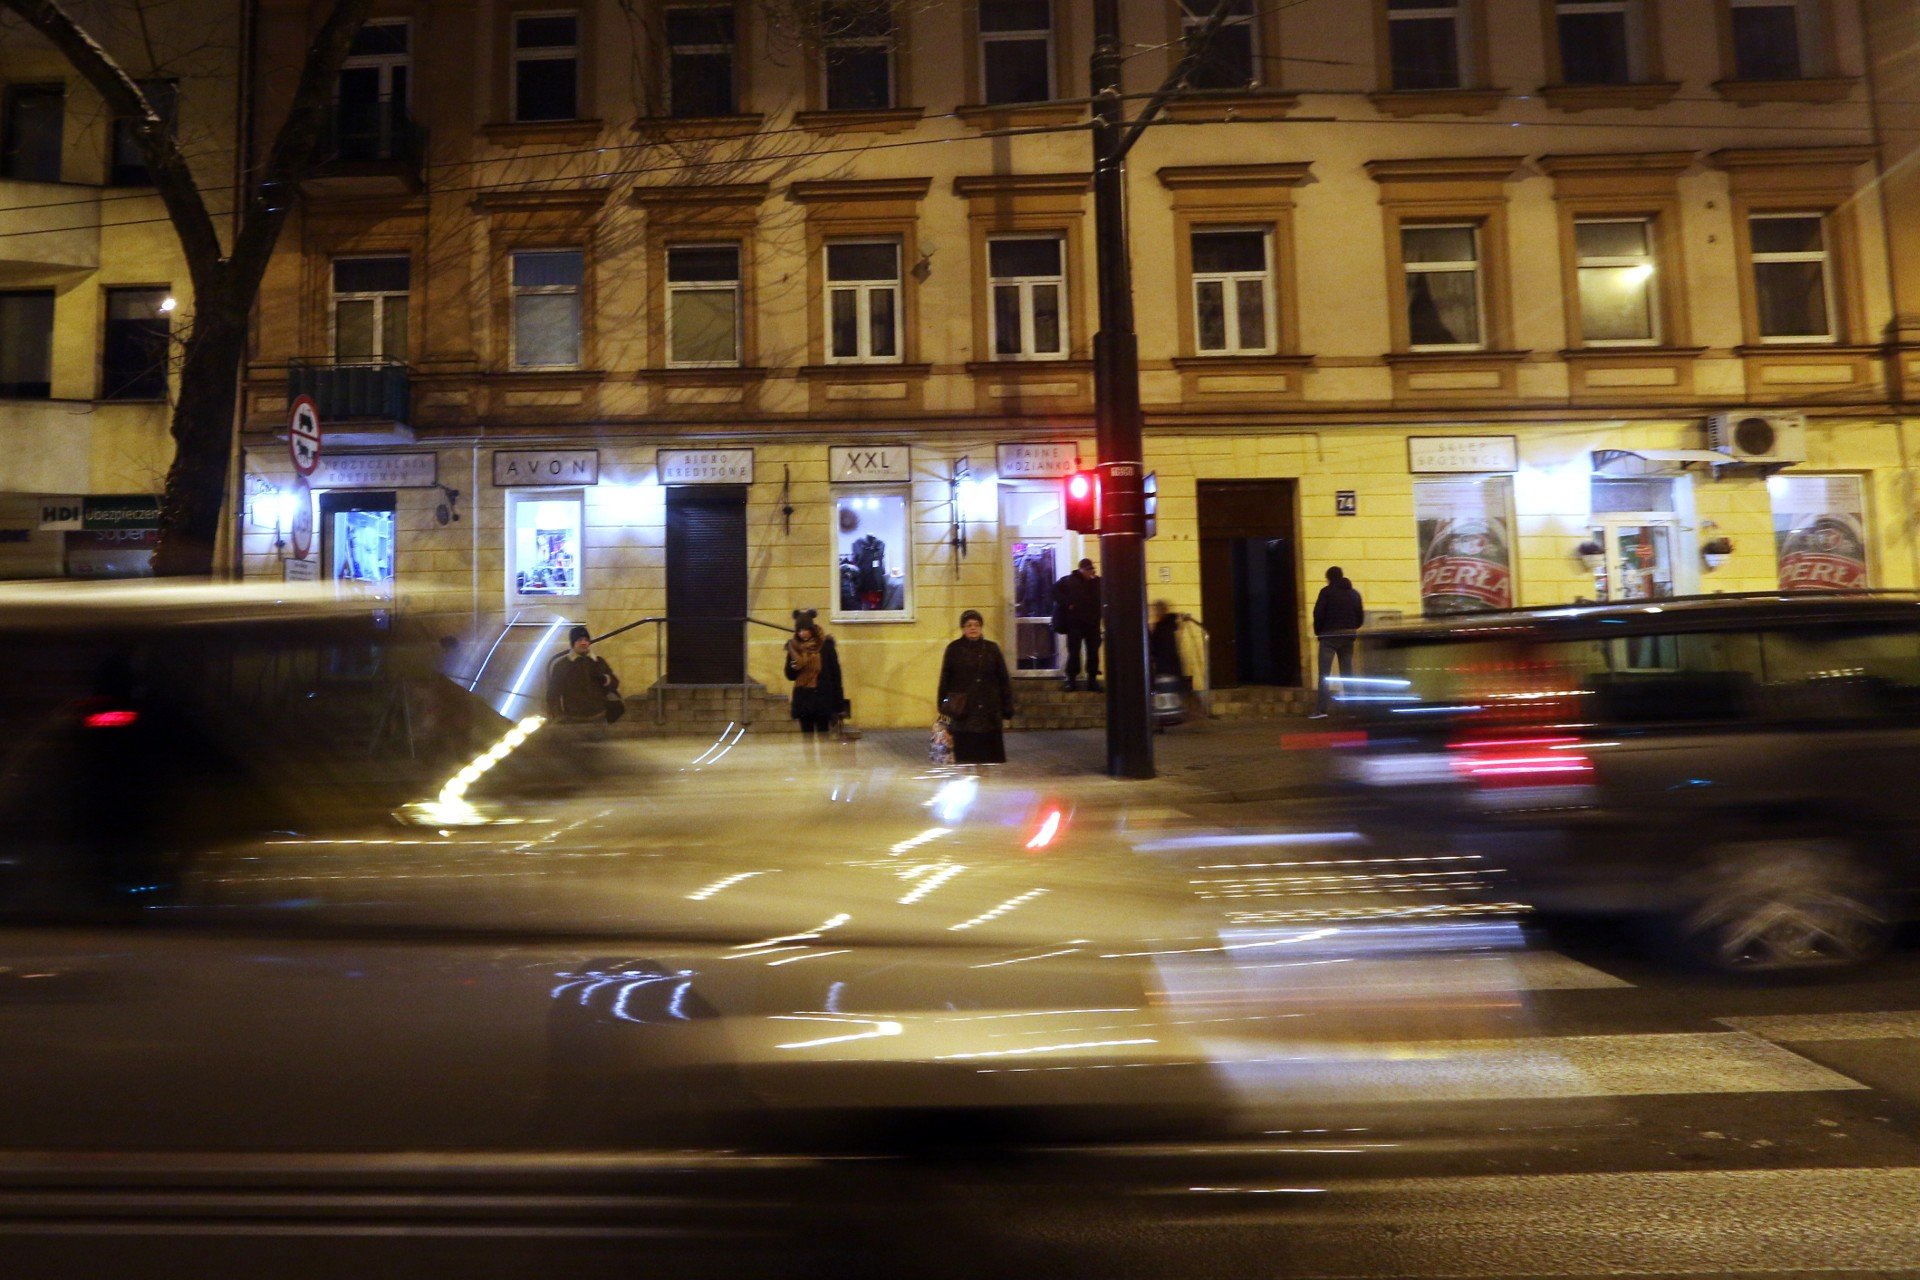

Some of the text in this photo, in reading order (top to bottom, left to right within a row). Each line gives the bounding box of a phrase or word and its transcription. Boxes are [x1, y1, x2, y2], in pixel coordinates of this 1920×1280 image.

[684, 454, 727, 464] BIURO
[847, 451, 890, 474] XXL
[506, 460, 585, 476] AVON
[667, 466, 747, 478] KREDYTOWE
[1337, 496, 1355, 510] 74
[42, 506, 79, 522] HDI
